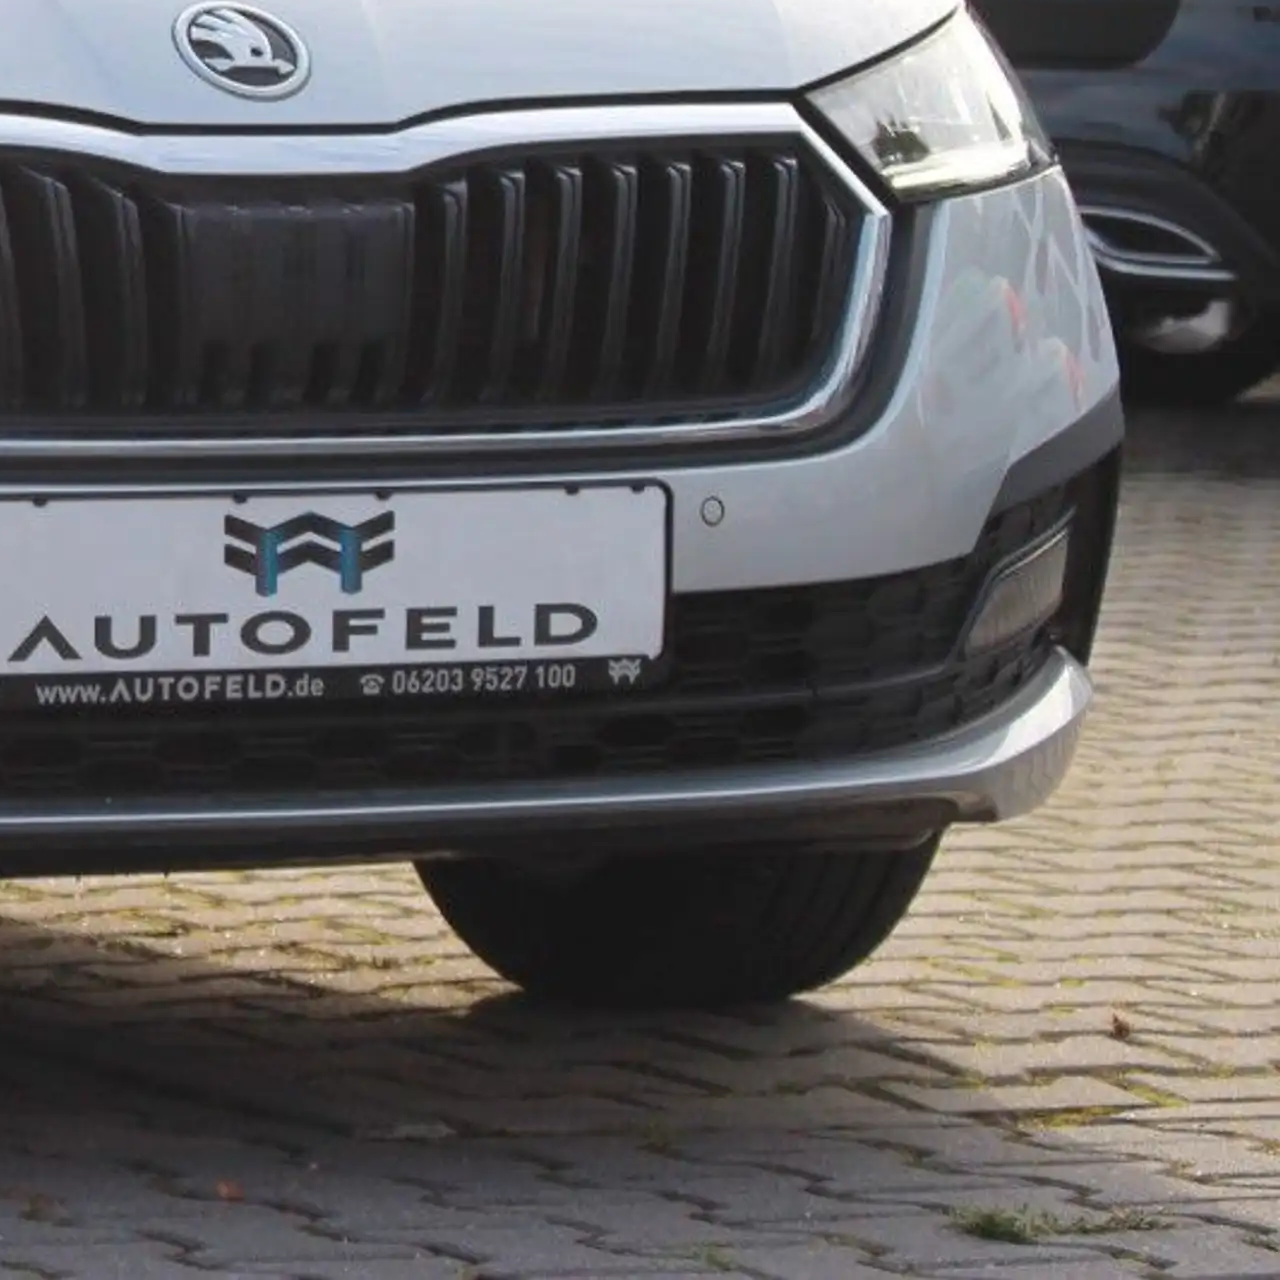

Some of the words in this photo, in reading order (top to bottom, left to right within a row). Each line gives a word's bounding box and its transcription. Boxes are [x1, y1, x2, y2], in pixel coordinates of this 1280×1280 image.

[7, 602, 598, 662] AUTOFELD
[35, 673, 324, 705] www.AUTOFELD.de
[392, 669, 464, 694] 06203
[470, 665, 527, 692] 9527
[536, 663, 577, 688] 100
